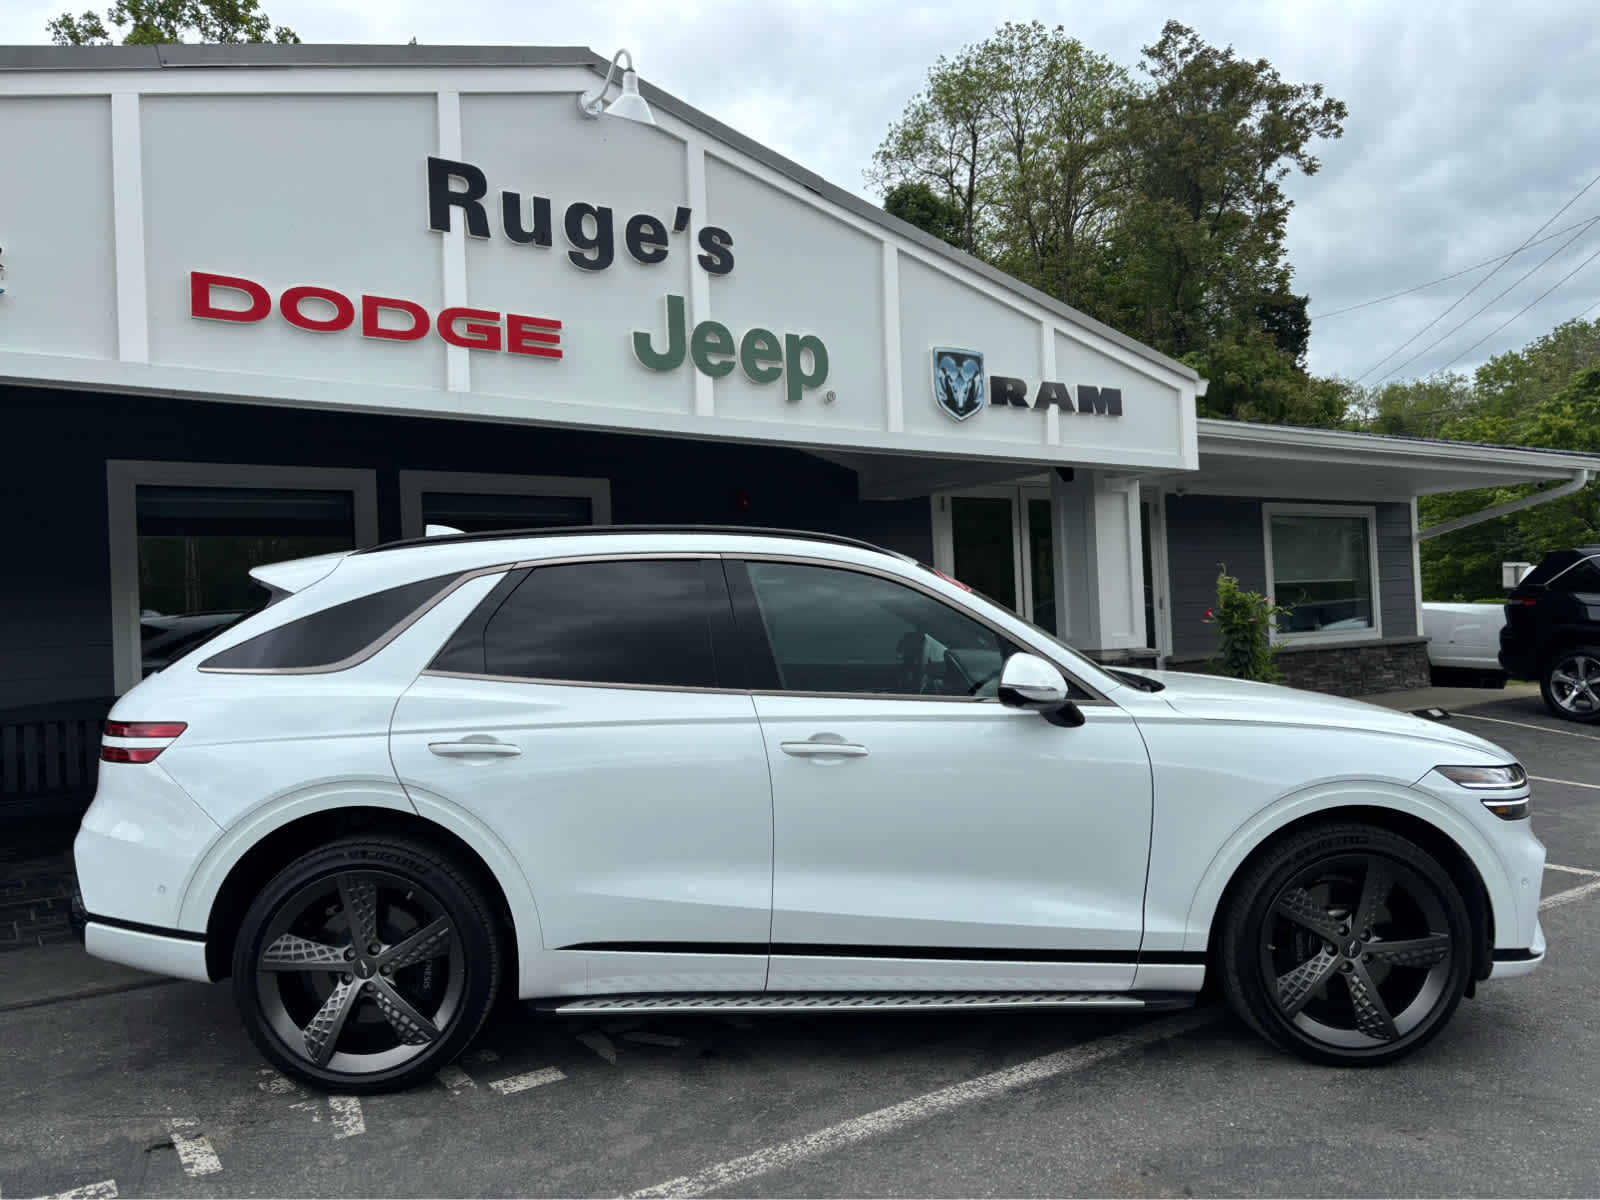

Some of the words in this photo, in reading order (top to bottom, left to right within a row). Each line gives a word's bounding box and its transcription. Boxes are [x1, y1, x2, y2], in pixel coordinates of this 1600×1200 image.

[428, 156, 735, 275] Ruge's
[191, 271, 562, 358] DODGE
[990, 376, 1122, 417] RAM
